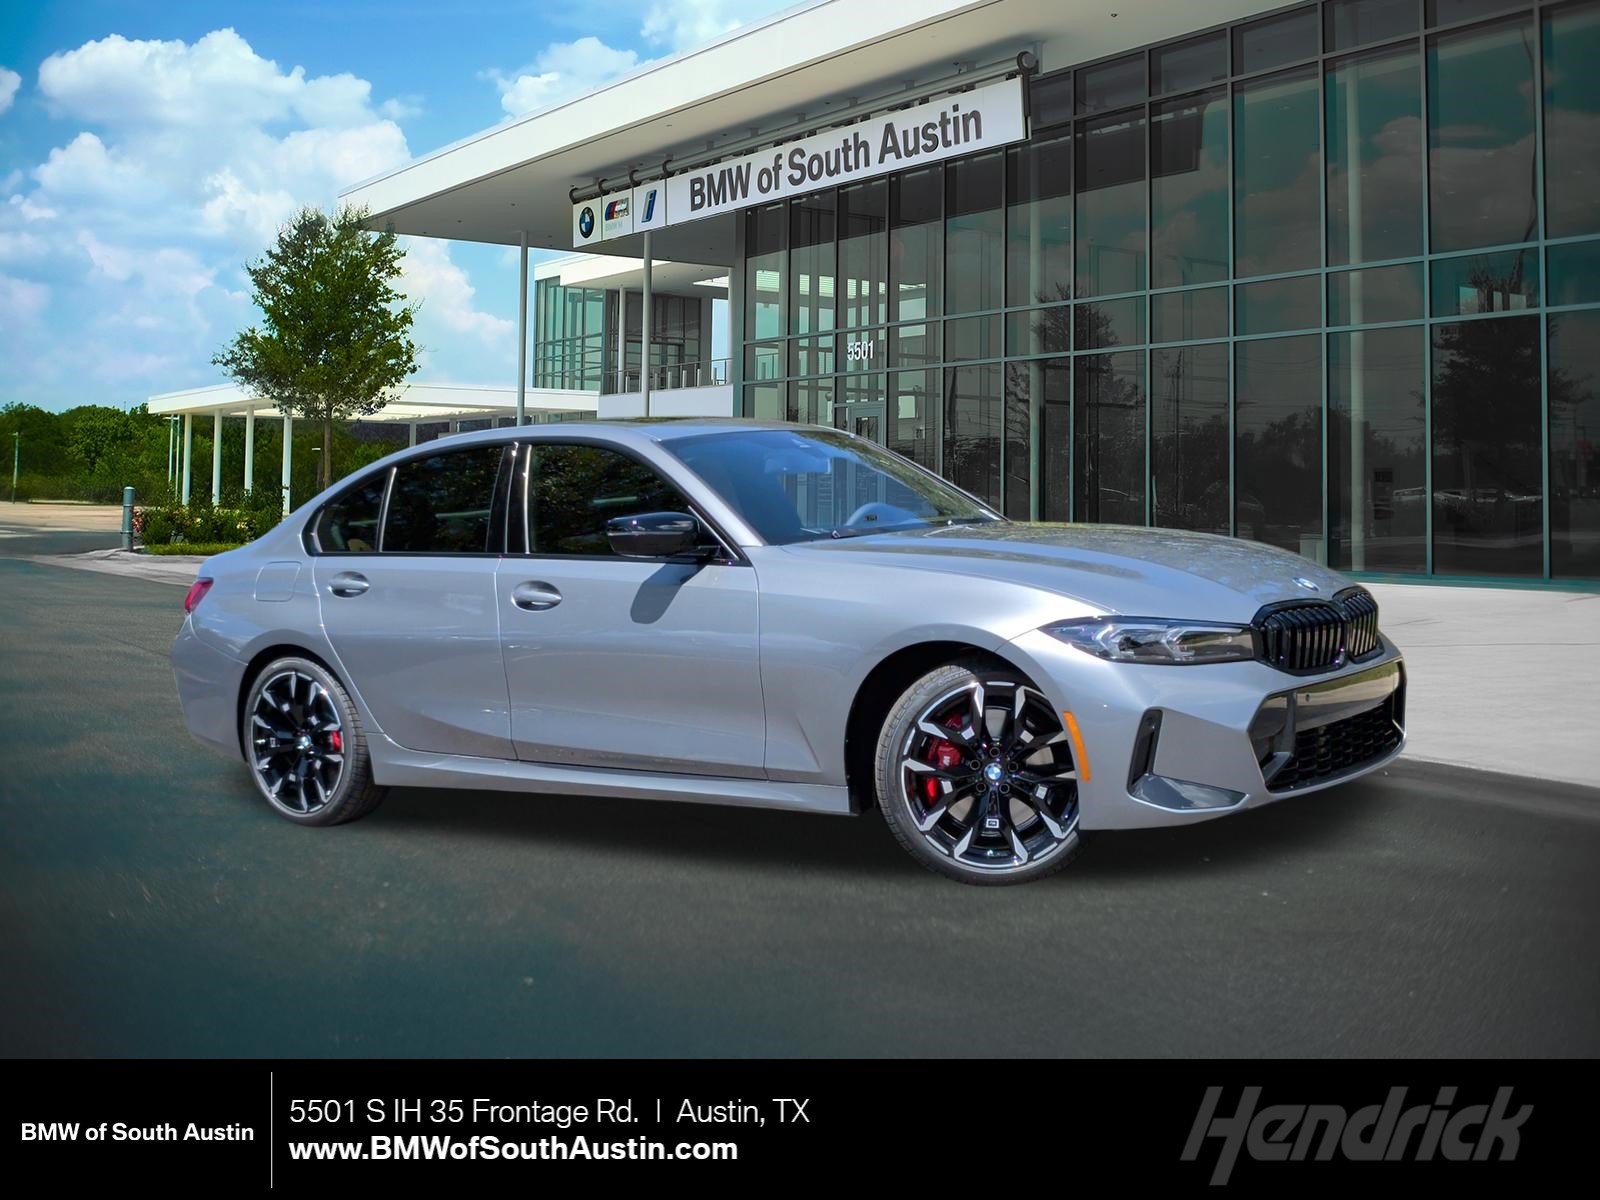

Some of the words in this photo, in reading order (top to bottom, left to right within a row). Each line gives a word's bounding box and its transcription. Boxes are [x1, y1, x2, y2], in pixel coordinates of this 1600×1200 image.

[690, 162, 752, 212] BMW
[757, 153, 783, 194] of
[787, 131, 871, 186] South
[878, 103, 983, 164] Austin
[847, 340, 874, 361] 5501
